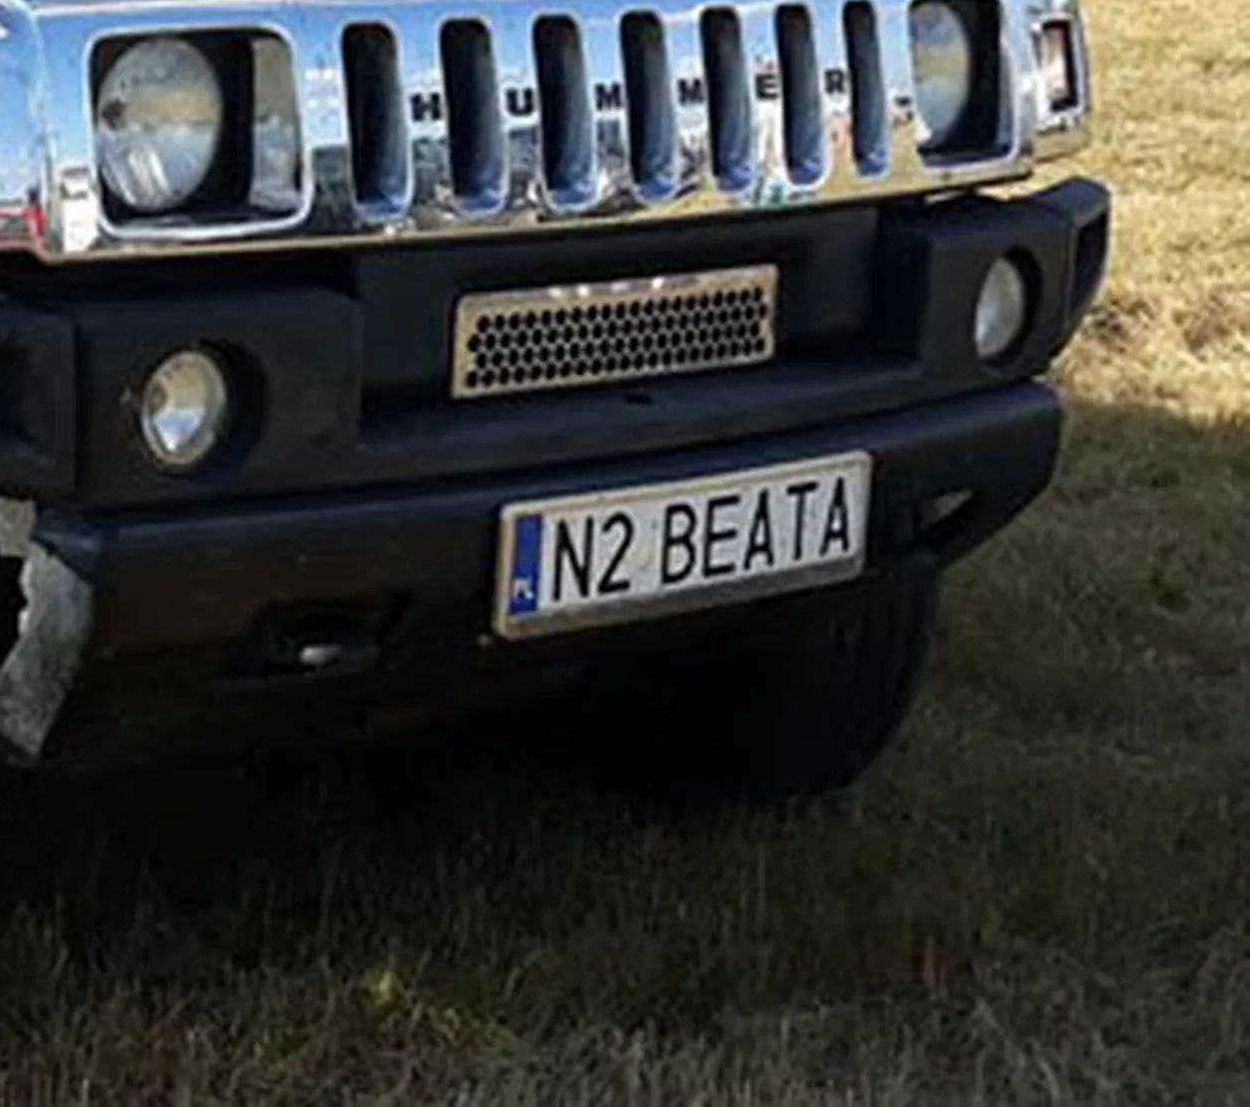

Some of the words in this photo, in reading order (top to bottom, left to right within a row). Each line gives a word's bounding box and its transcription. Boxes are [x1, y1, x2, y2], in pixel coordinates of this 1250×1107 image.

[410, 68, 847, 123] HUMMER
[553, 511, 634, 600] N2
[661, 477, 849, 584] BEATA
